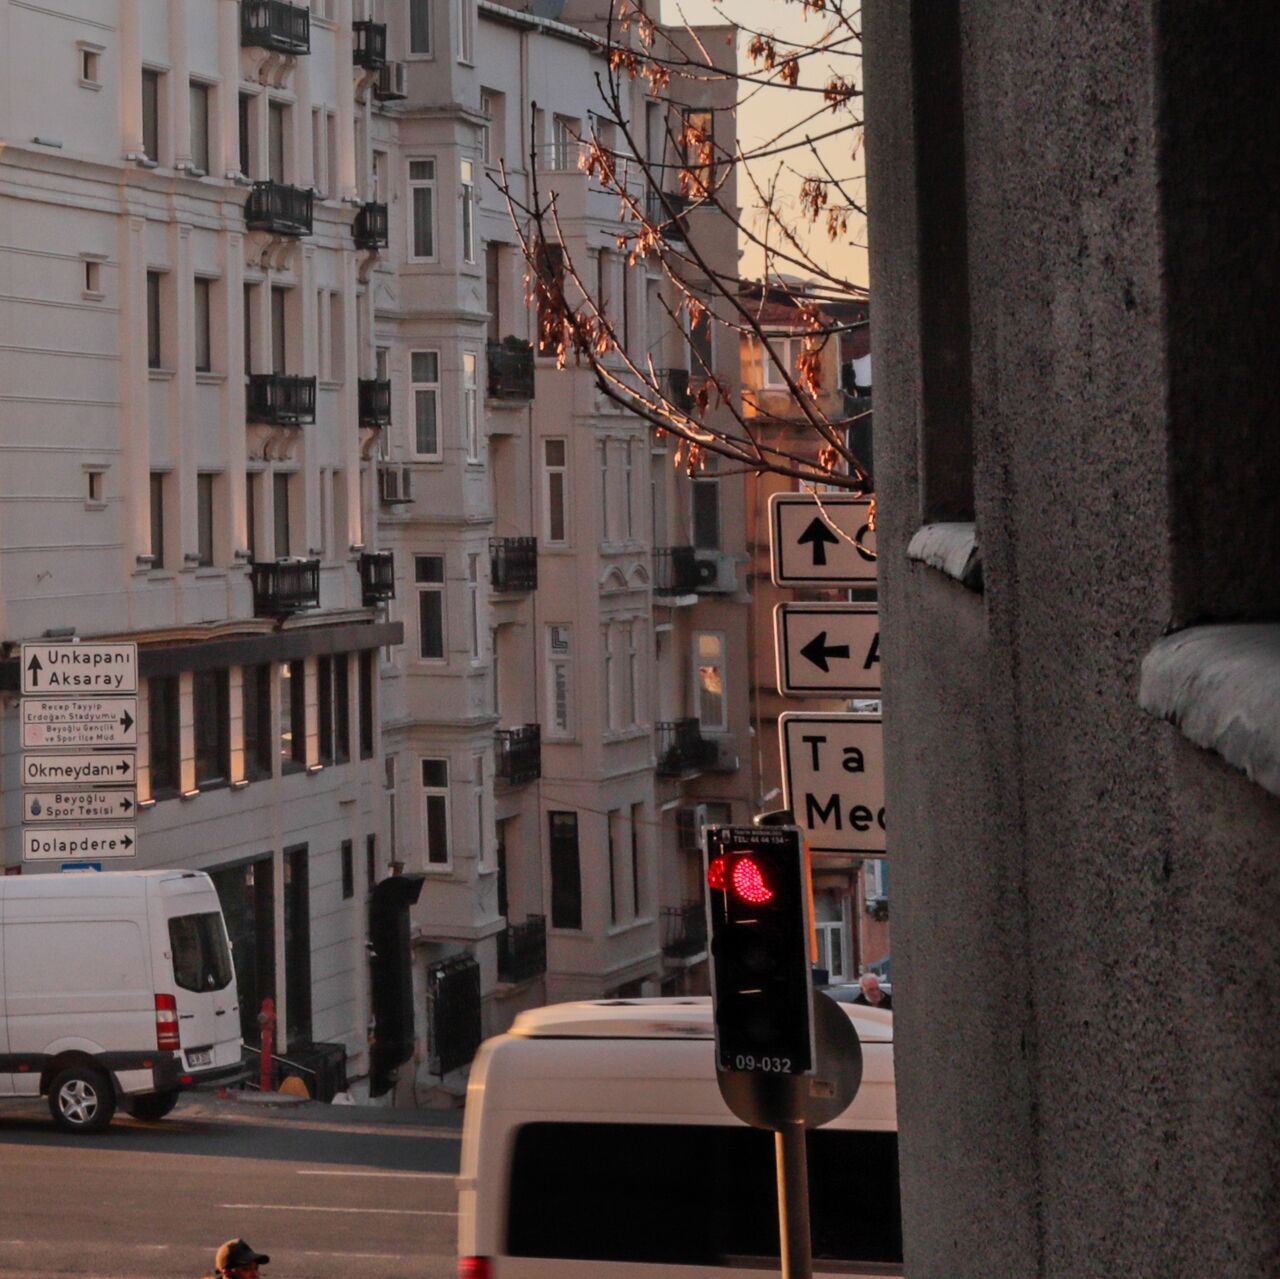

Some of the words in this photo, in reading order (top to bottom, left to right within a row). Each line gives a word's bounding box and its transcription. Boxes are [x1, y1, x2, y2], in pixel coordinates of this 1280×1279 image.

[48, 650, 131, 670] Unkapanı
[49, 672, 124, 689] Aksaray
[41, 703, 70, 711] Recep
[73, 702, 103, 711] Tayyip
[27, 713, 66, 722] Erdoğan
[69, 712, 117, 721] Stadyumu
[28, 762, 114, 780] Okmeydanı
[55, 793, 106, 806] Beyoğlu
[46, 806, 74, 818] Spor
[79, 805, 114, 816] Tesisi
[31, 836, 117, 857] Dolapdere
[735, 1054, 792, 1074] 09-032
